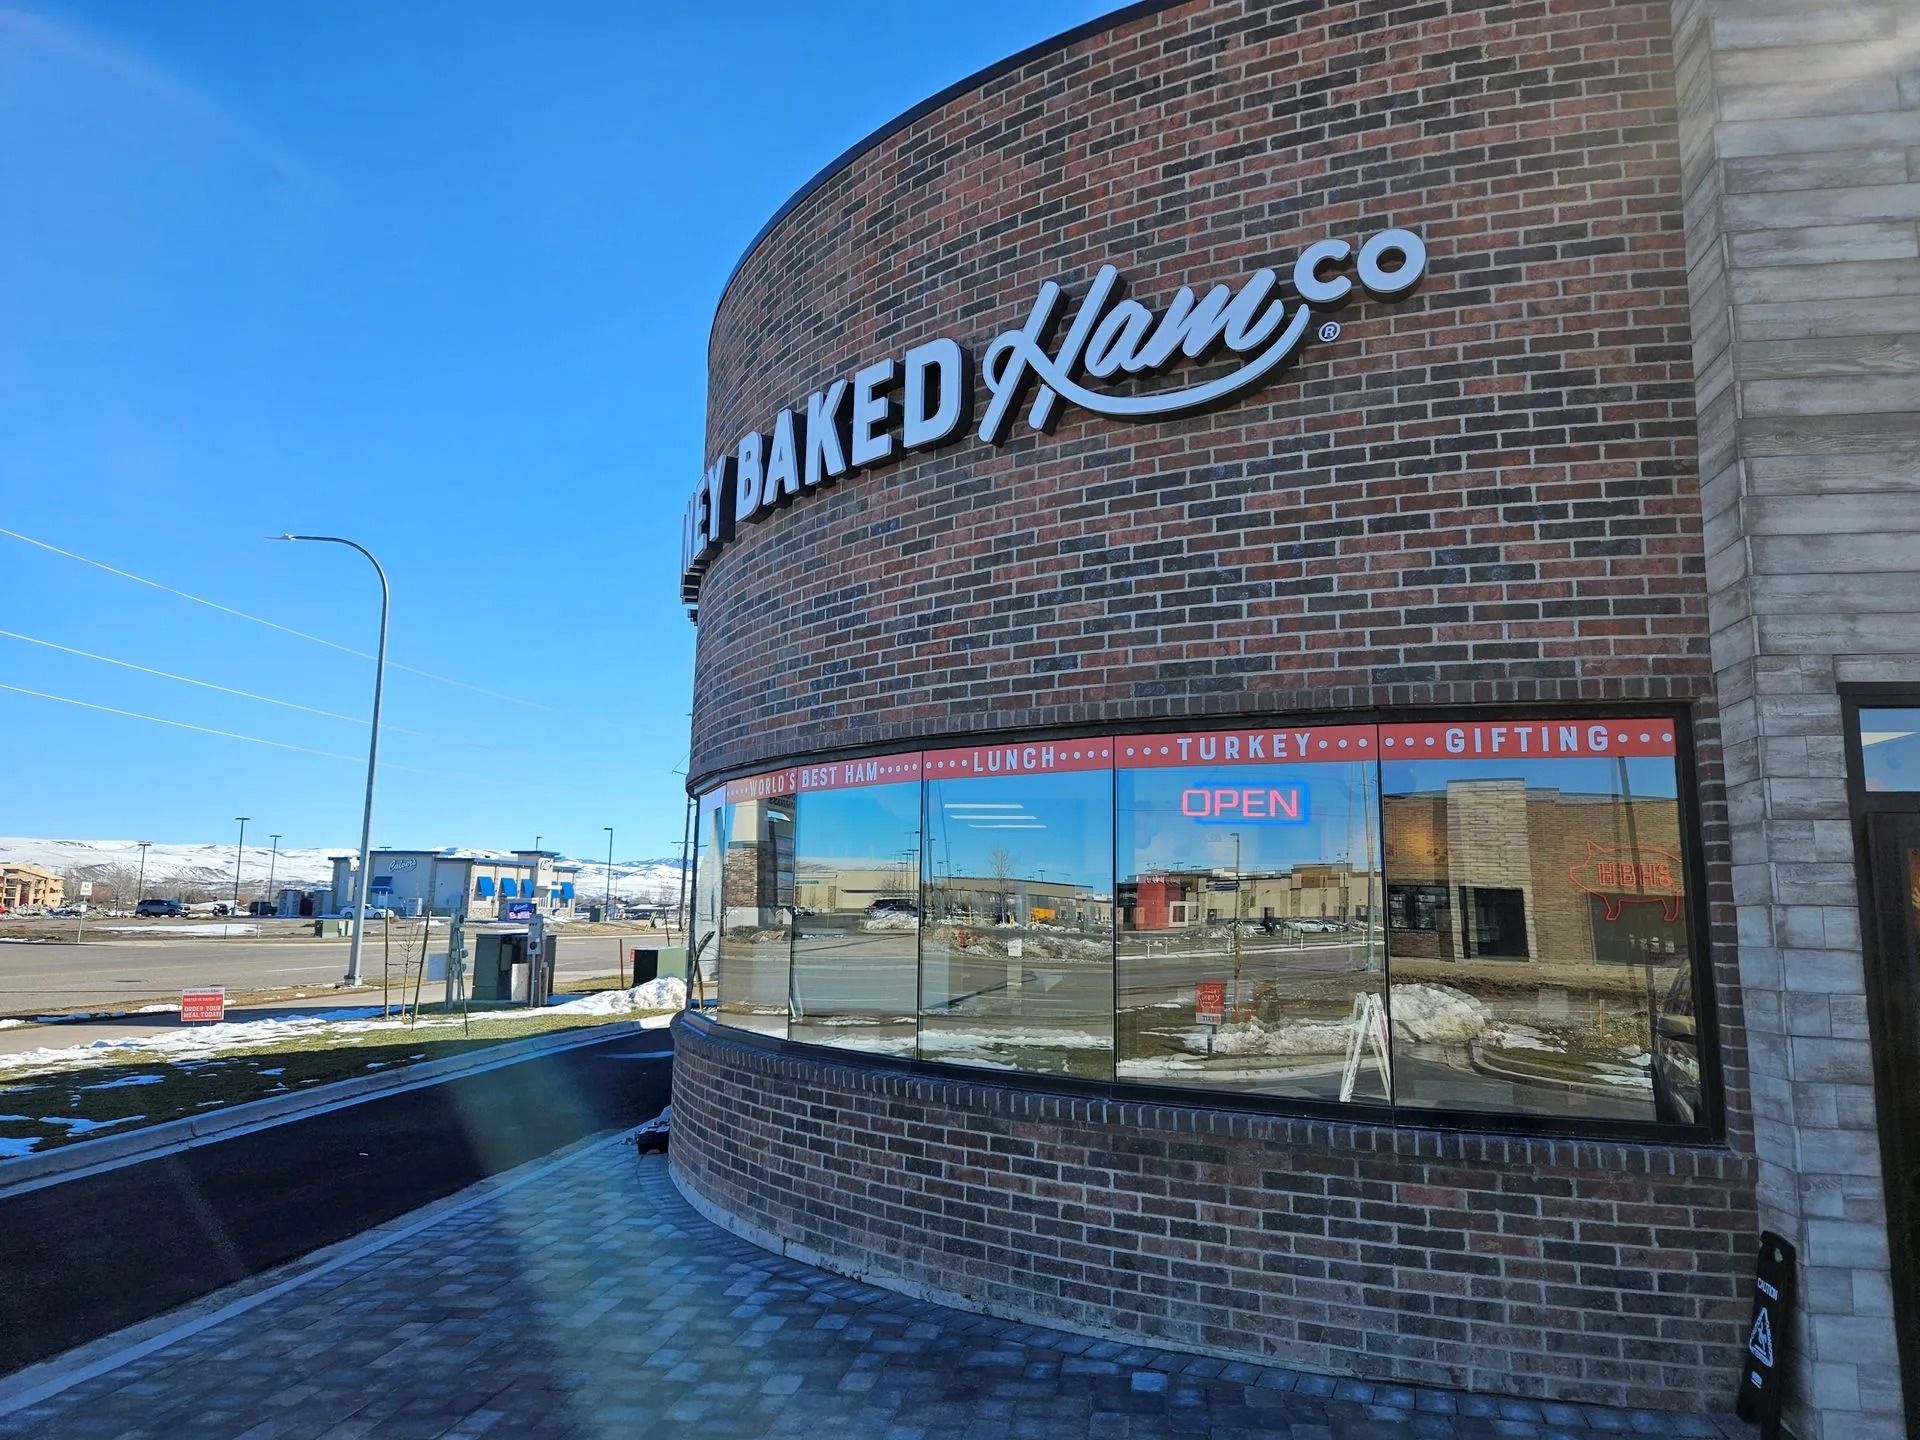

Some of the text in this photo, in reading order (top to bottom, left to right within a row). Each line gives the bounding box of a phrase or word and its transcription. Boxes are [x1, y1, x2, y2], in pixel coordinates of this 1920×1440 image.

[736, 338, 962, 522] BAKED
[978, 264, 1310, 443] Ham
[1294, 228, 1427, 301] CO
[1177, 733, 1311, 761] TURKEY
[1445, 725, 1609, 753] GIFTING
[973, 746, 1054, 772] LUNCH
[749, 761, 878, 797] WORLD'S BEST HAM
[1181, 788, 1298, 817] OPEN
[1597, 862, 1657, 887] HBH
